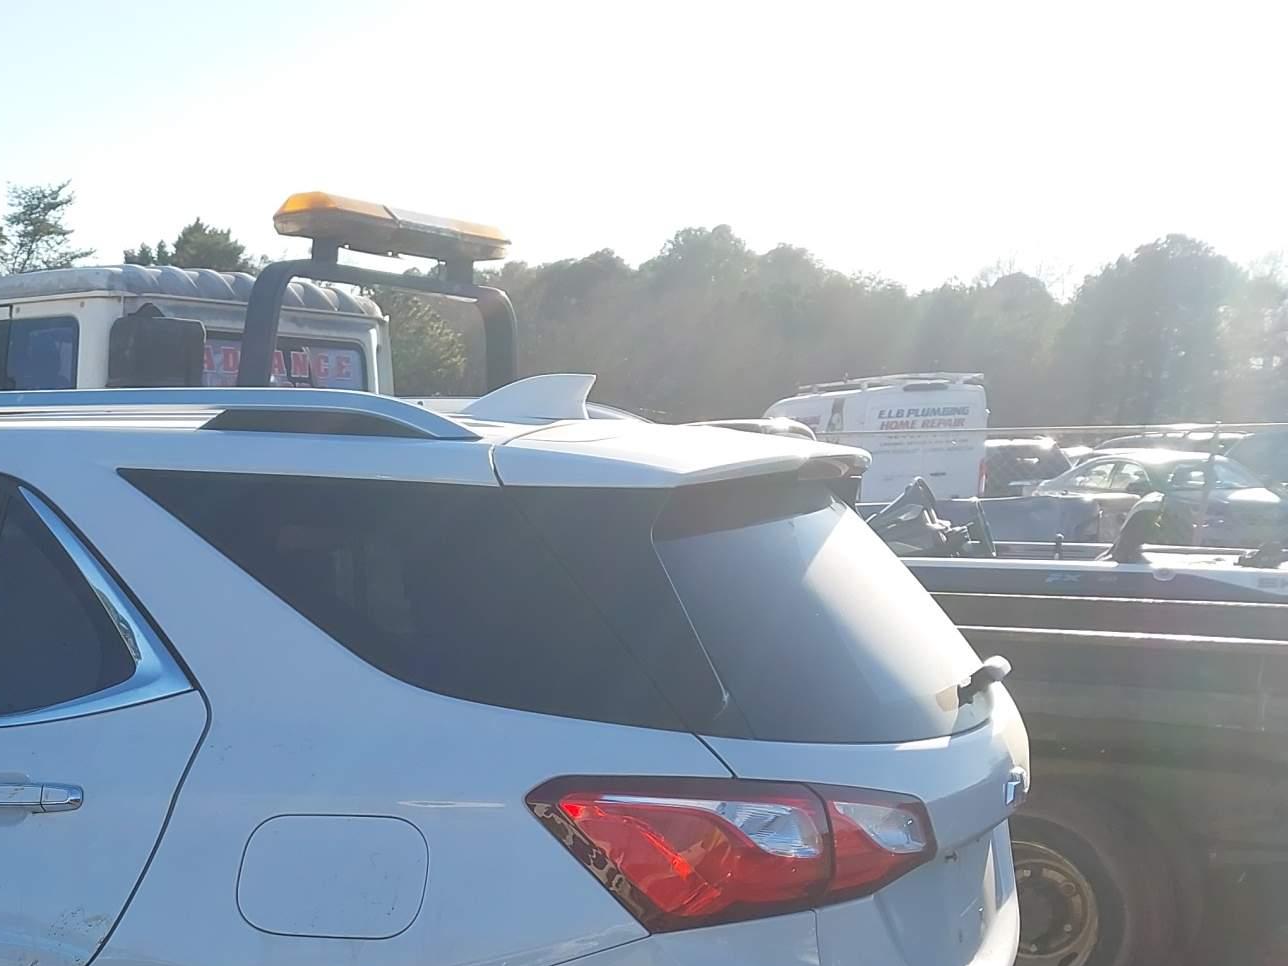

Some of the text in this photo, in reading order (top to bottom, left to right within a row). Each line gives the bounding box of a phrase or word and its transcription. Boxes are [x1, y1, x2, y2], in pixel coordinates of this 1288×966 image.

[204, 345, 353, 380] ADANCE
[906, 406, 970, 418] PLUMBING
[880, 418, 966, 431] HOME REPAIR
